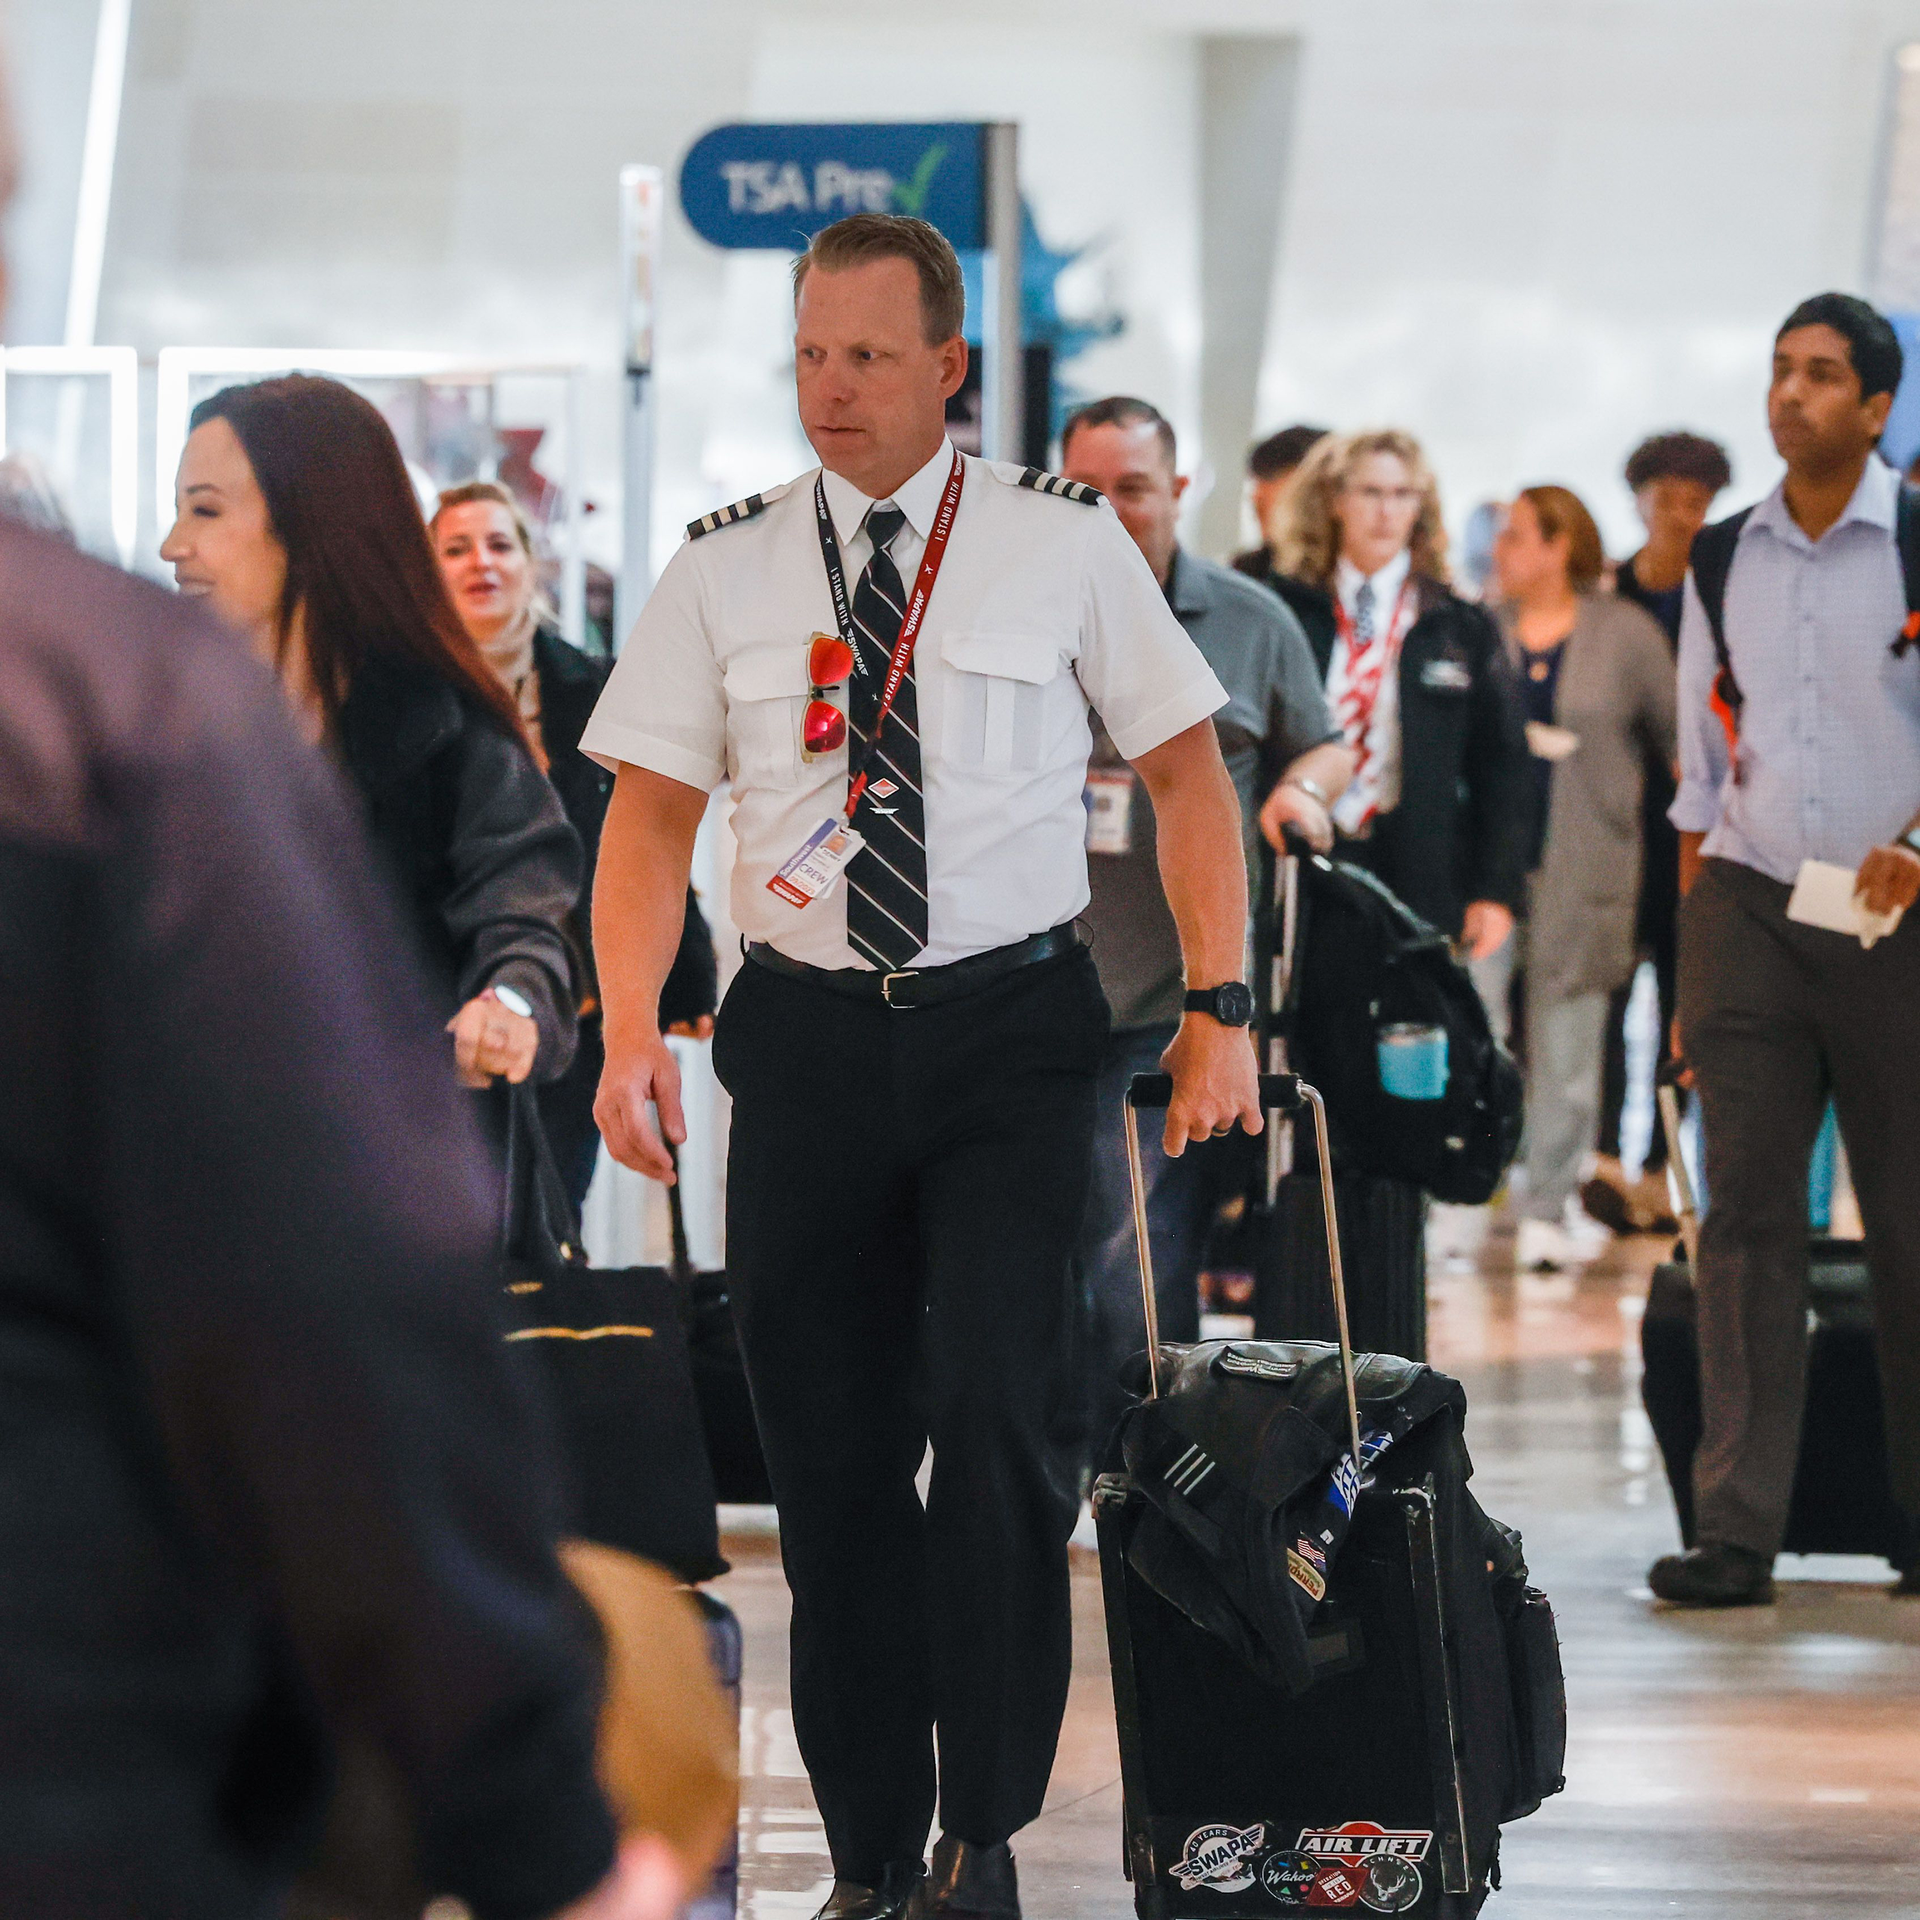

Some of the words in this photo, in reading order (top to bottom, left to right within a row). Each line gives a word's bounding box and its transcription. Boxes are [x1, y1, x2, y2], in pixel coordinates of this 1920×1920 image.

[722, 160, 810, 213] TSA
[936, 505, 953, 535] STAND
[946, 481, 960, 505] WITH
[830, 573, 843, 603] STAND
[837, 602, 850, 626] WITH
[847, 637, 866, 672] SWAPA
[885, 668, 901, 701] STAND
[894, 642, 910, 668] WITH
[906, 596, 925, 632] SWAPA
[779, 844, 813, 877] Southwest
[799, 863, 829, 885] CREW
[1290, 1563, 1319, 1597] PERRO
[1188, 1834, 1255, 1876] SWAPA
[1189, 1841, 1199, 1853] 40
[1198, 1829, 1228, 1842] YEARS
[1303, 1837, 1353, 1853] AIR
[1360, 1838, 1422, 1854] LIFT
[1266, 1869, 1315, 1885] Wahoo
[1326, 1881, 1352, 1900] RED
